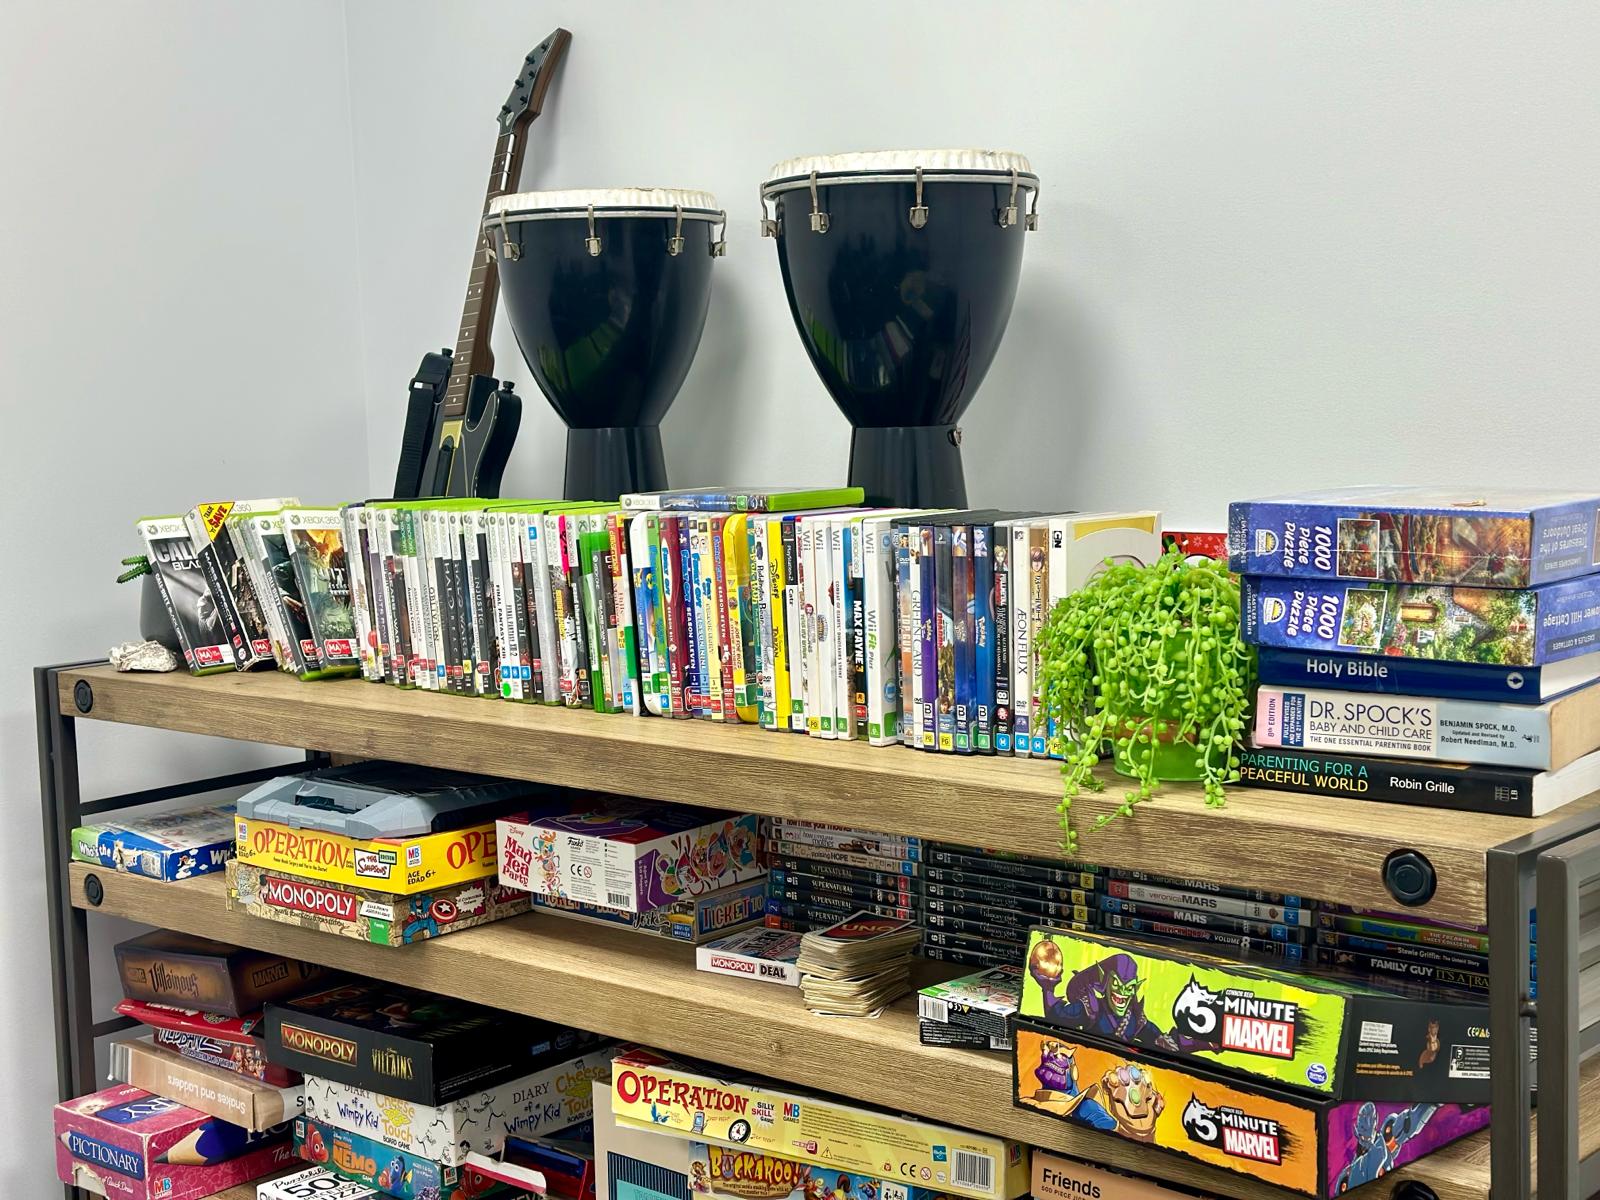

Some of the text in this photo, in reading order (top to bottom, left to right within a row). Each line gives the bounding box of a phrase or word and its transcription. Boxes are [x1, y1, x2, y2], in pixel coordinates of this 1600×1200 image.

[209, 505, 228, 528] SAVE
[803, 530, 811, 551] Wii
[815, 529, 824, 550] Wii
[832, 530, 840, 550] Wii
[865, 533, 874, 554] Wii
[1283, 522, 1296, 569] puzzle
[1299, 527, 1310, 565] piece
[1314, 525, 1333, 571] 1000
[444, 562, 455, 608] HALO
[496, 584, 504, 606] FINAL
[429, 586, 440, 641] OBLIVION
[454, 562, 468, 657] HALO WARS
[474, 575, 484, 630] INJUSTICE
[513, 587, 525, 626] FABLE
[1287, 591, 1304, 637] puzzle
[498, 608, 506, 641] FANTASY
[867, 610, 877, 632] Wii
[1302, 596, 1318, 633] piece
[1318, 595, 1339, 639] 1000
[1543, 609, 1583, 627] Hill Cottage
[685, 607, 697, 669] SEASON ELEVEN
[853, 600, 864, 672] MAX PAYNE 3
[868, 633, 877, 650] Fit
[902, 615, 911, 653] TOP GUN
[912, 590, 923, 676] GREEN CARD
[1018, 643, 1028, 675] FLUX
[1306, 658, 1388, 678] Holy Bible
[1268, 698, 1276, 726] EDITION
[1310, 701, 1432, 727] DR. SPOCK'S
[1310, 721, 1432, 740] BABY AND CHILD CARE
[1440, 719, 1518, 733] BENJAMIN SPOCK, M.D.
[1338, 738, 1373, 747] ESSENTIAL
[1375, 740, 1412, 750] PARENTING
[1413, 743, 1431, 751] BOOK
[1441, 735, 1463, 744] Robert
[1501, 740, 1517, 749] M.D.
[1240, 753, 1368, 778] PARENTING FOR A
[1240, 766, 1368, 792] PEACEFUL WORLD
[1390, 776, 1455, 794] Robin Grille
[508, 824, 524, 837] Disney
[79, 841, 98, 857] Who's
[99, 845, 111, 858] the
[253, 828, 350, 870] OPERATION
[407, 847, 420, 859] MB
[504, 837, 532, 865] Mad
[830, 851, 849, 862] HOPE
[407, 870, 420, 879] AGE
[425, 869, 436, 879] 6+
[504, 852, 529, 877] Tea
[810, 864, 852, 877] SUPERNATURAL
[408, 875, 425, 885] EDAD
[502, 867, 529, 887] Party
[811, 879, 853, 894] SUPERNATURAL
[1184, 879, 1220, 892] MARS
[269, 882, 353, 915] MONOPOLY
[810, 895, 852, 908] SUPERNATURAL
[1181, 895, 1217, 909] MARS
[703, 897, 750, 931] TICKET
[1173, 911, 1207, 925] MARS
[841, 923, 892, 932] UNO
[1214, 935, 1250, 949] VOLUME 8
[1398, 947, 1419, 957] Stewie
[254, 963, 288, 988] MARVEL
[712, 958, 786, 979] MONOPOLY DEAL
[1370, 958, 1433, 977] FAMILY GUY
[149, 961, 200, 998] Villainous
[1224, 998, 1295, 1023] MINUTE
[284, 1029, 355, 1062] MONOPOLY
[1224, 1017, 1291, 1055] MARVEL
[371, 1049, 414, 1080] VILLAINS
[555, 1066, 606, 1094] Cheese
[168, 1075, 246, 1114] Snakes and Ladders
[512, 1082, 550, 1105] DIARY
[617, 1071, 749, 1116] OPERATION
[337, 1101, 379, 1129] Wimpy Kid
[567, 1112, 586, 1123] BOARD
[751, 1107, 772, 1118] SKILL
[757, 1101, 775, 1111] SILLY
[784, 1102, 800, 1117] MB
[504, 1102, 561, 1134] Wimpy Kid
[760, 1116, 774, 1124] GAME
[783, 1116, 800, 1124] GAMES
[1221, 1113, 1278, 1136] MINUTE
[381, 1119, 414, 1144] Touch
[383, 1135, 411, 1151] BOARD GAME
[72, 1135, 139, 1175] PICTIONARY
[273, 1147, 291, 1163] The
[1224, 1129, 1279, 1161] MARVEL
[333, 1146, 377, 1175] NEMO
[709, 1147, 801, 1186] BUCKAROO!
[445, 1168, 457, 1179] MB
[1043, 1168, 1100, 1198] Friends
[154, 1178, 172, 1193] MB
[1041, 1185, 1071, 1199] 500 PIECE
